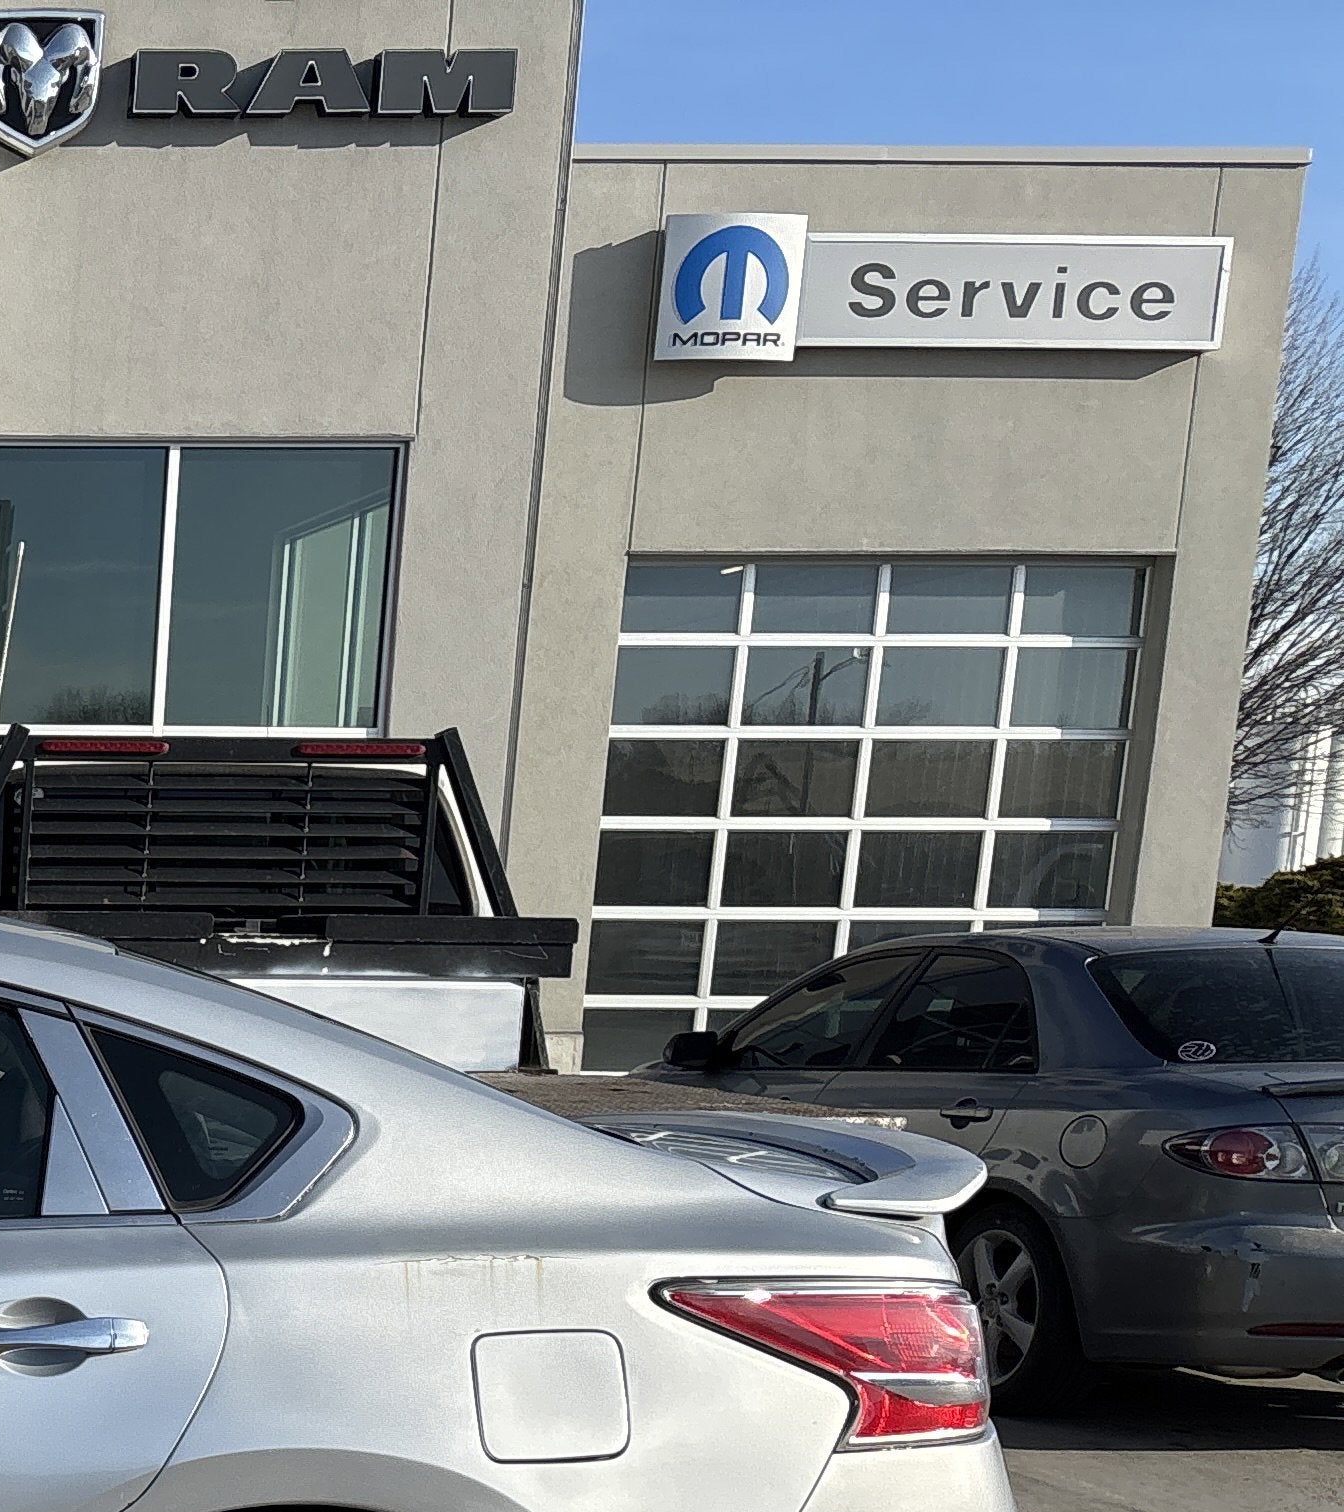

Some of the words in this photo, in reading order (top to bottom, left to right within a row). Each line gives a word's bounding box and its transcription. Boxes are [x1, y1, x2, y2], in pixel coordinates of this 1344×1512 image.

[130, 48, 518, 116] RAM
[848, 262, 1176, 321] Service
[672, 331, 781, 347] MOPAR
